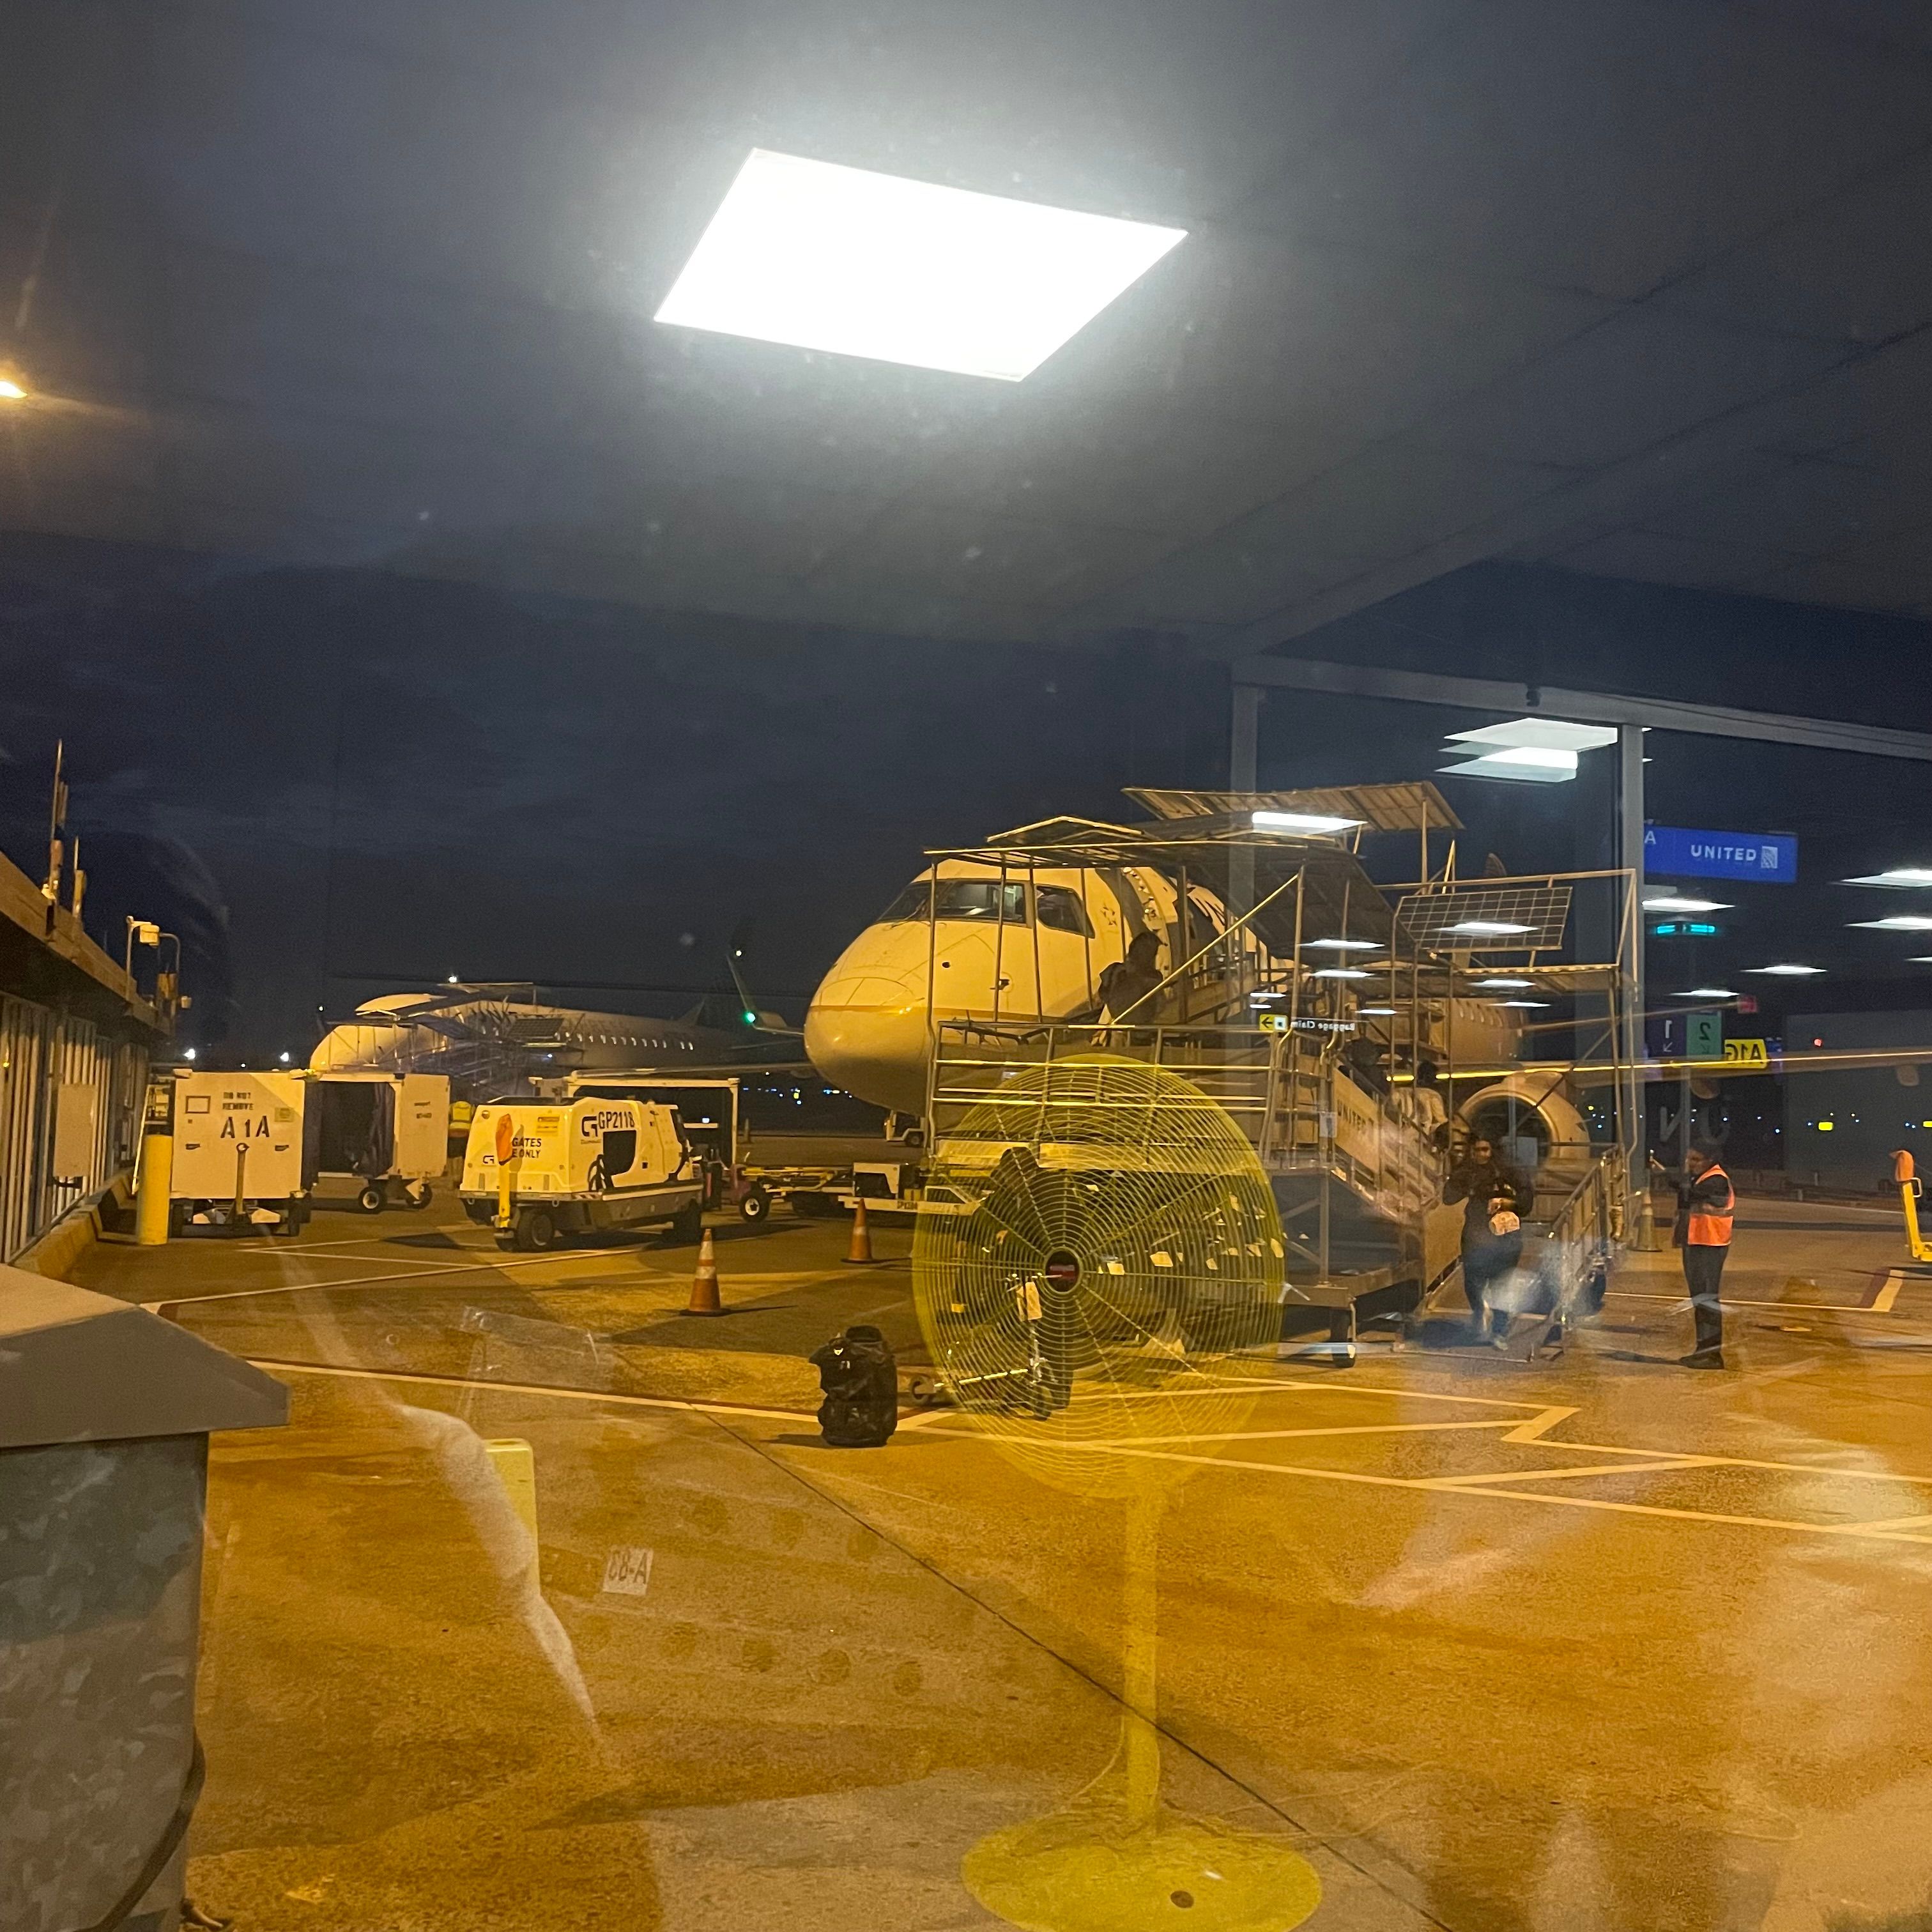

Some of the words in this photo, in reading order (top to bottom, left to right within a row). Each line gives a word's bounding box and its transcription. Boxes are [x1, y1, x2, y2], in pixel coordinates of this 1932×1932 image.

[1690, 845, 1756, 861] UNITED
[598, 1111, 636, 1129] GP2118
[512, 1138, 542, 1147] GATES
[519, 1150, 541, 1158] ONLY
